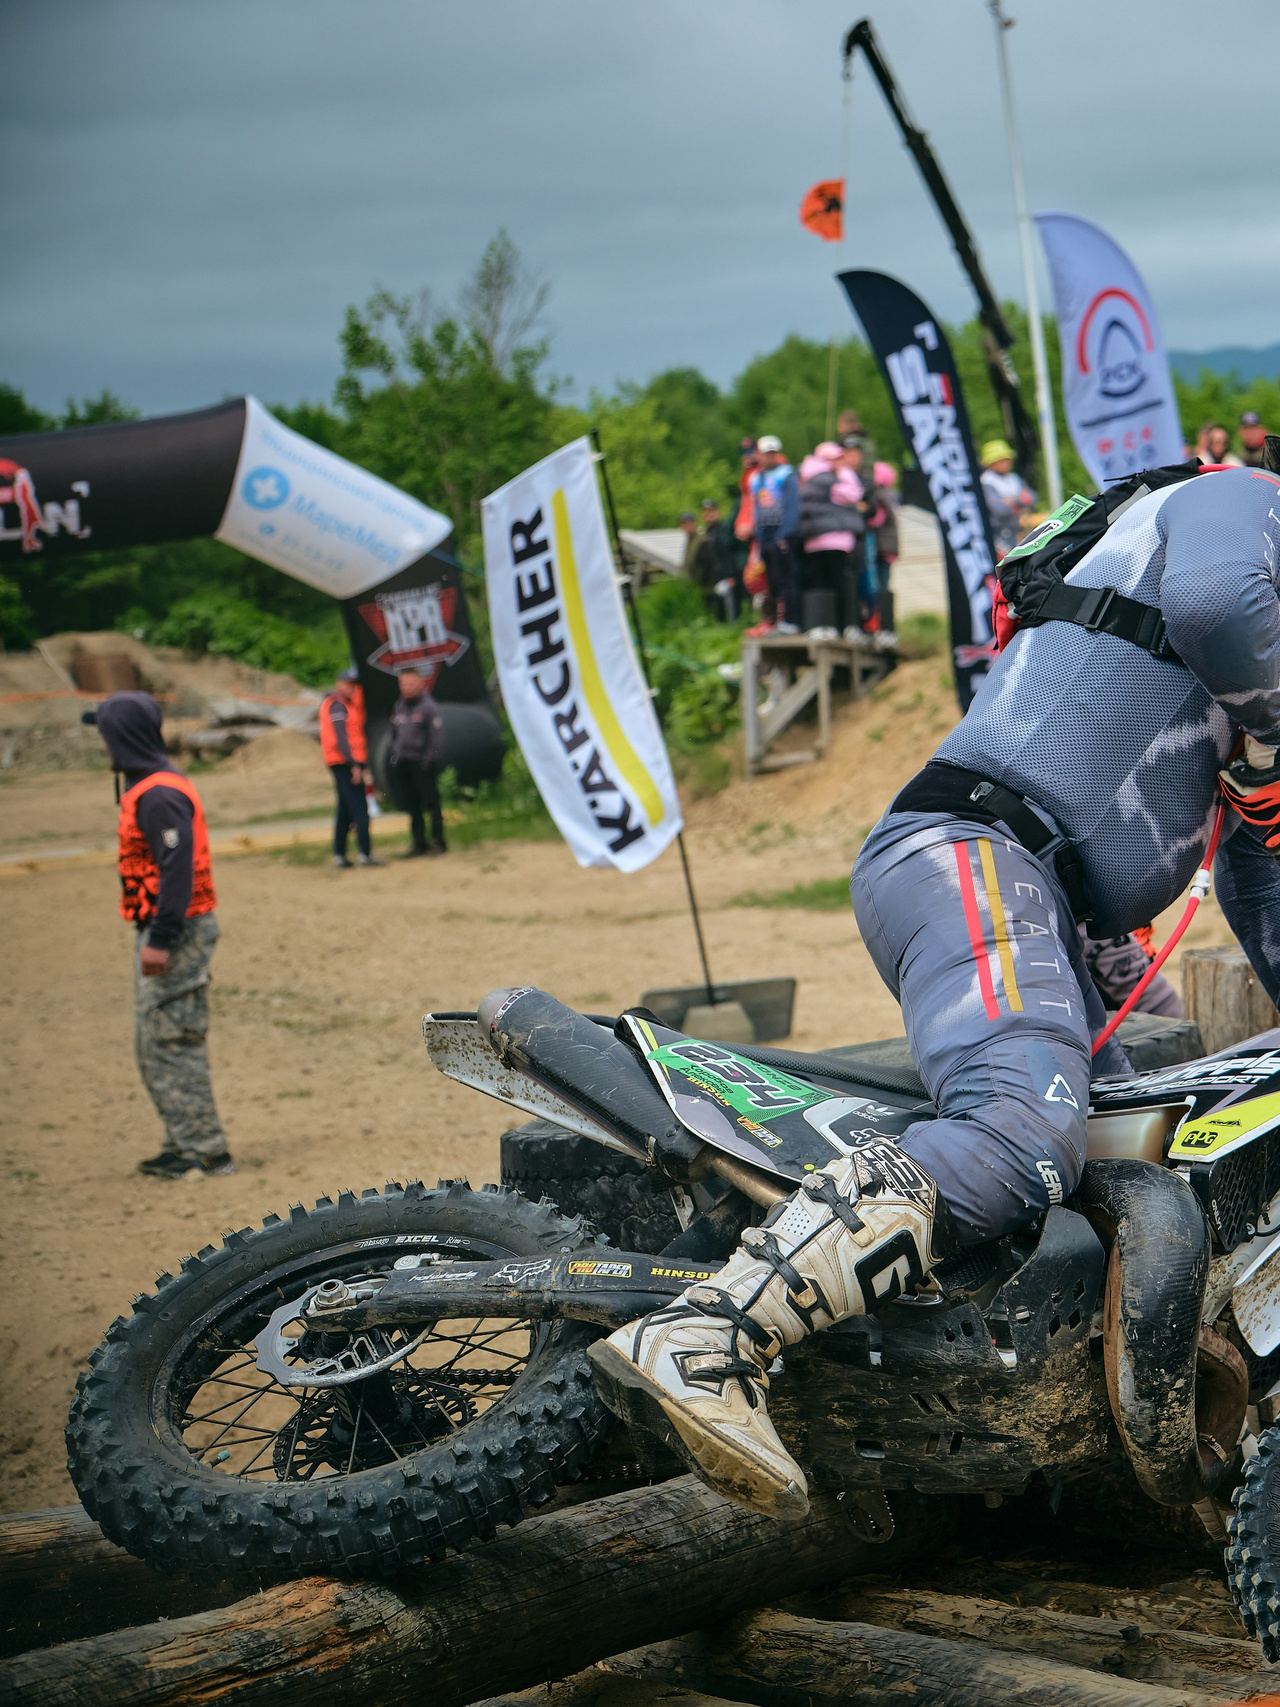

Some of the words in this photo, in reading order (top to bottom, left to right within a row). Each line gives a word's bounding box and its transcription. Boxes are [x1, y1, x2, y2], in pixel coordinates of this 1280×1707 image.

[509, 506, 645, 855] KÄRCHER
[1099, 1075, 1271, 1100] MOTORSPORT
[852, 1109, 880, 1123] adidas
[1183, 1130, 1218, 1148] PPG
[394, 1235, 440, 1244] EXCEL
